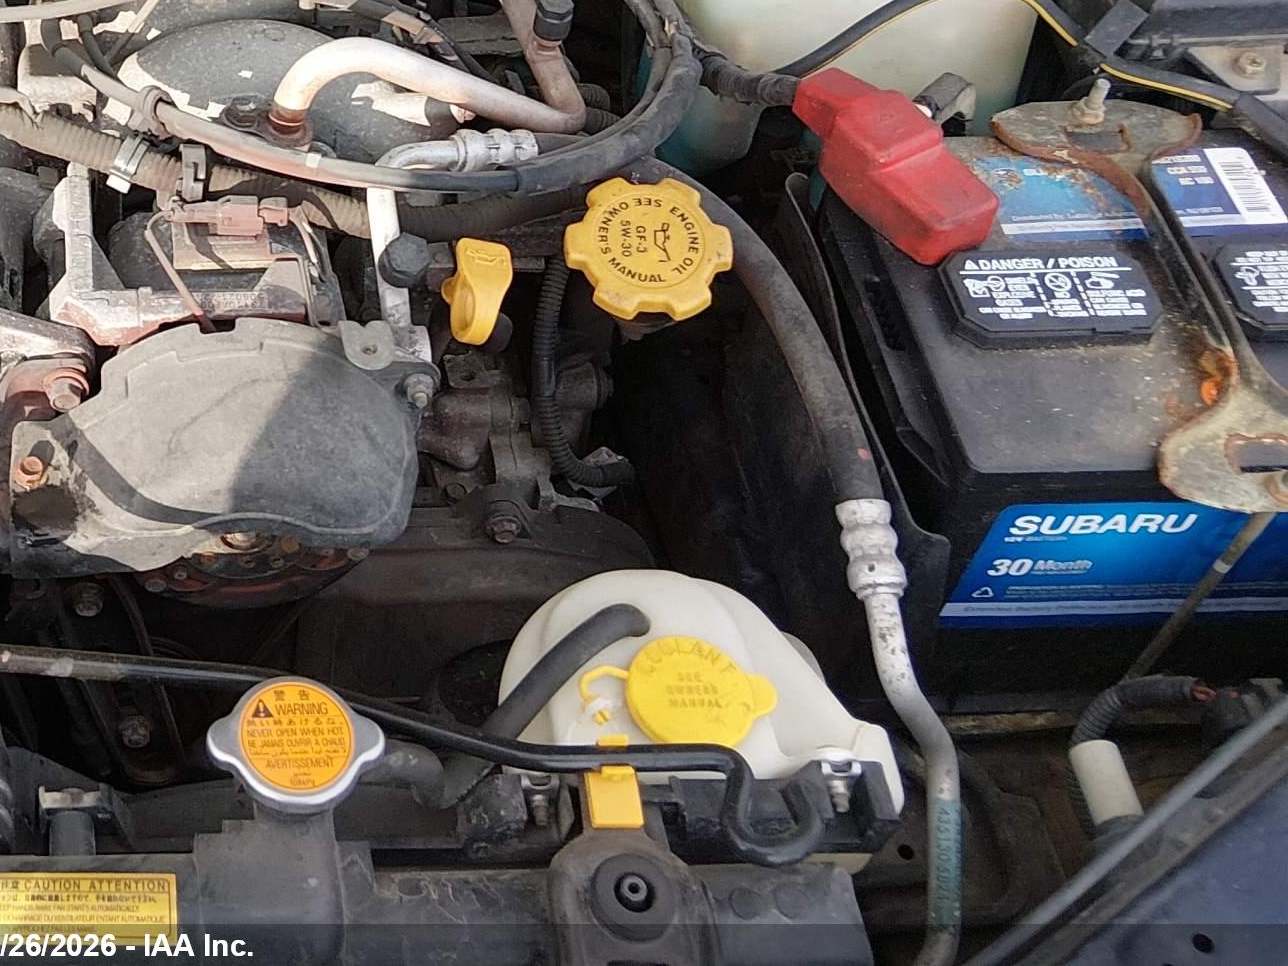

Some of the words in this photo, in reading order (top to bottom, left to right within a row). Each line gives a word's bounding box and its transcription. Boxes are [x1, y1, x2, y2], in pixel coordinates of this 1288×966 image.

[631, 197, 664, 209] SEE
[598, 201, 629, 255] OWNER'S
[669, 206, 699, 255] ENGINE
[672, 256, 695, 275] OIL
[978, 258, 1045, 270] DANGER
[1058, 256, 1118, 268] POISON
[608, 258, 667, 283] MANUAL
[1009, 513, 1199, 536] SUBARU
[987, 558, 1033, 576] 30
[1033, 559, 1093, 571] Month
[636, 637, 737, 675] COOLANT
[677, 671, 703, 682] SEE
[275, 702, 329, 715] WARNING
[668, 698, 723, 709] MANUAL
[246, 728, 272, 737] NEVER
[275, 727, 297, 736] OPEN
[299, 727, 324, 736] WHEN
[265, 756, 334, 770] AVERTISSEMENT
[24, 880, 81, 891] CAUTION
[88, 880, 166, 891] ATTENTION
